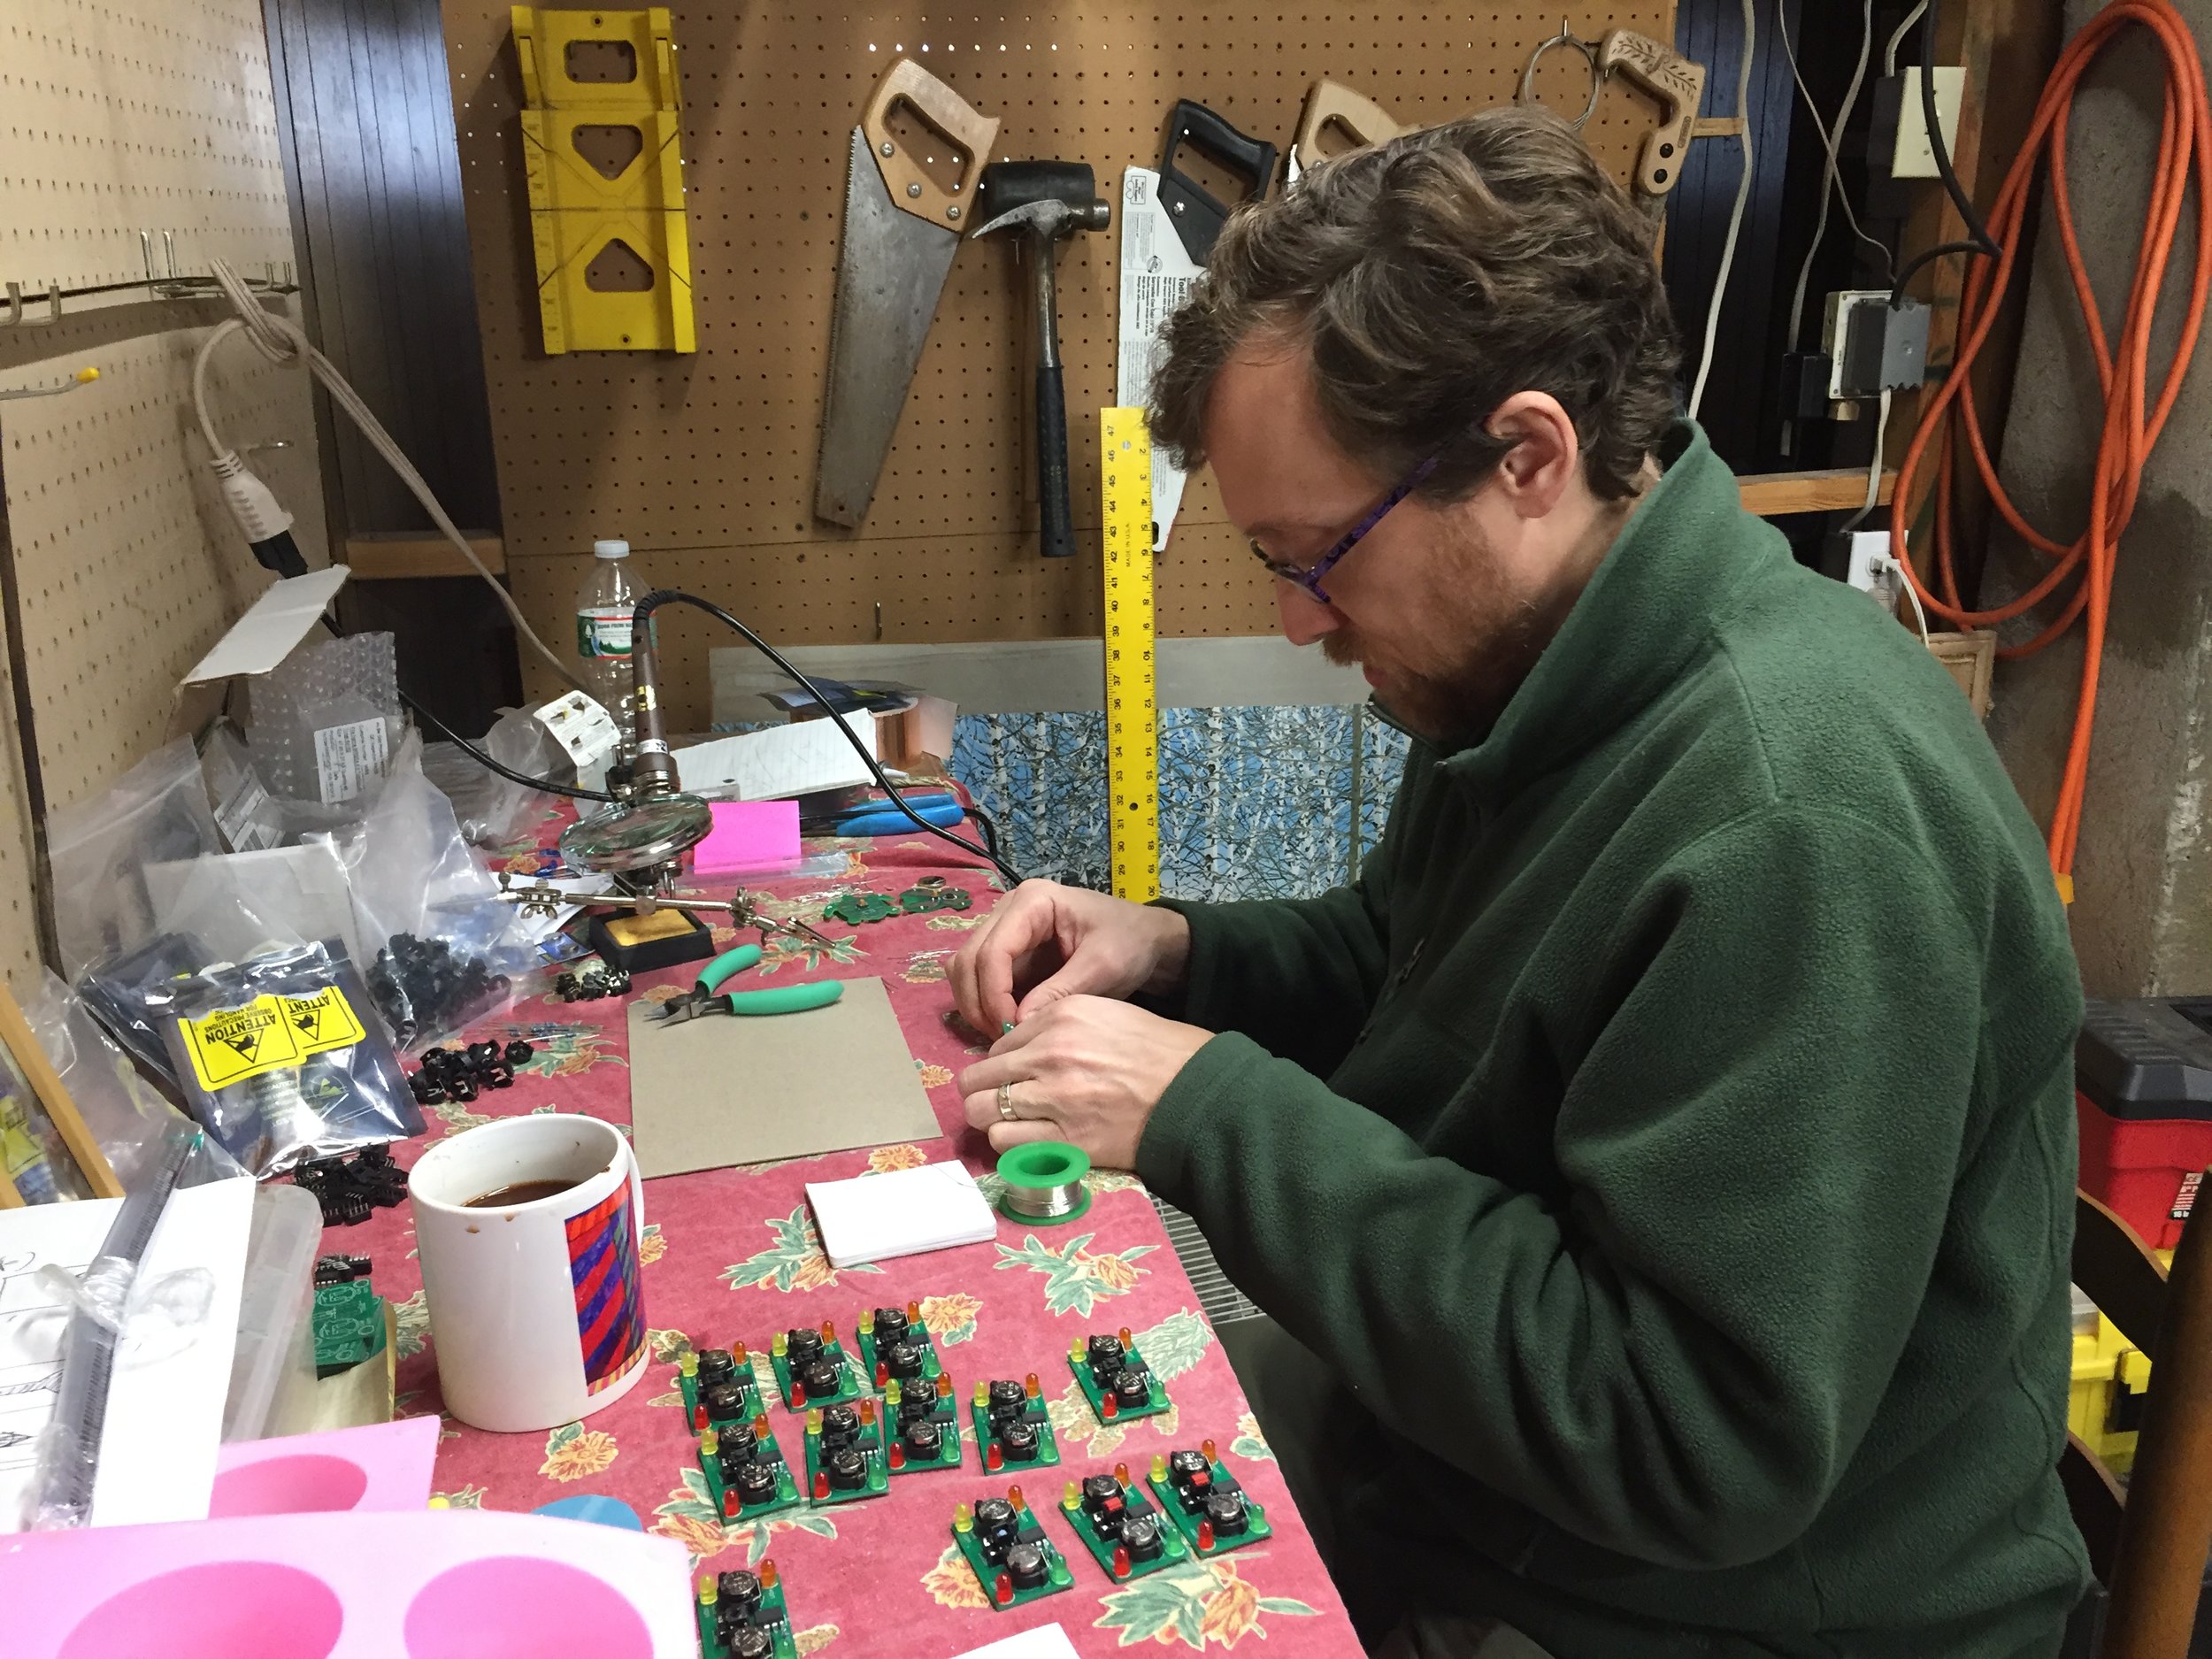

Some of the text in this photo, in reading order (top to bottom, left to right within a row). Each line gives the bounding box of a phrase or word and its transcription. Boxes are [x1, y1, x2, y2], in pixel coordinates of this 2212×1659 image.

[1107, 426, 1114, 436] 47
[1108, 449, 1115, 462] 46
[1109, 475, 1116, 487] 45
[1109, 500, 1116, 513] 44
[1110, 526, 1117, 538] 43
[1111, 551, 1118, 563] 42
[1112, 577, 1118, 588] 41
[1112, 600, 1118, 612] 40
[1113, 626, 1120, 637] 39
[1113, 650, 1120, 661] 38
[1144, 650, 1150, 661] 10
[1114, 675, 1120, 687] 37
[1144, 674, 1150, 684] 11
[1114, 699, 1121, 710] 36
[1145, 699, 1151, 708] 12
[1115, 722, 1122, 734] 35
[1145, 722, 1152, 733] 13
[1116, 746, 1122, 757] 34
[1146, 746, 1152, 757] 14
[1116, 770, 1123, 782] 33
[1147, 770, 1152, 780] 15
[1117, 795, 1123, 806] 32
[1147, 794, 1153, 804] 16
[1118, 818, 1124, 830] 31
[1148, 818, 1153, 827] 17
[1118, 841, 1125, 853] 30
[1148, 840, 1154, 850] 18
[1118, 864, 1125, 876] 29
[1148, 864, 1154, 874] 19
[1119, 888, 1125, 899] 28
[1148, 886, 1155, 896] 20
[246, 1004, 257, 1013] FOR
[204, 1008, 273, 1033] OBSERVE PRECAUTIONS
[205, 1014, 276, 1045] ATTENTION
